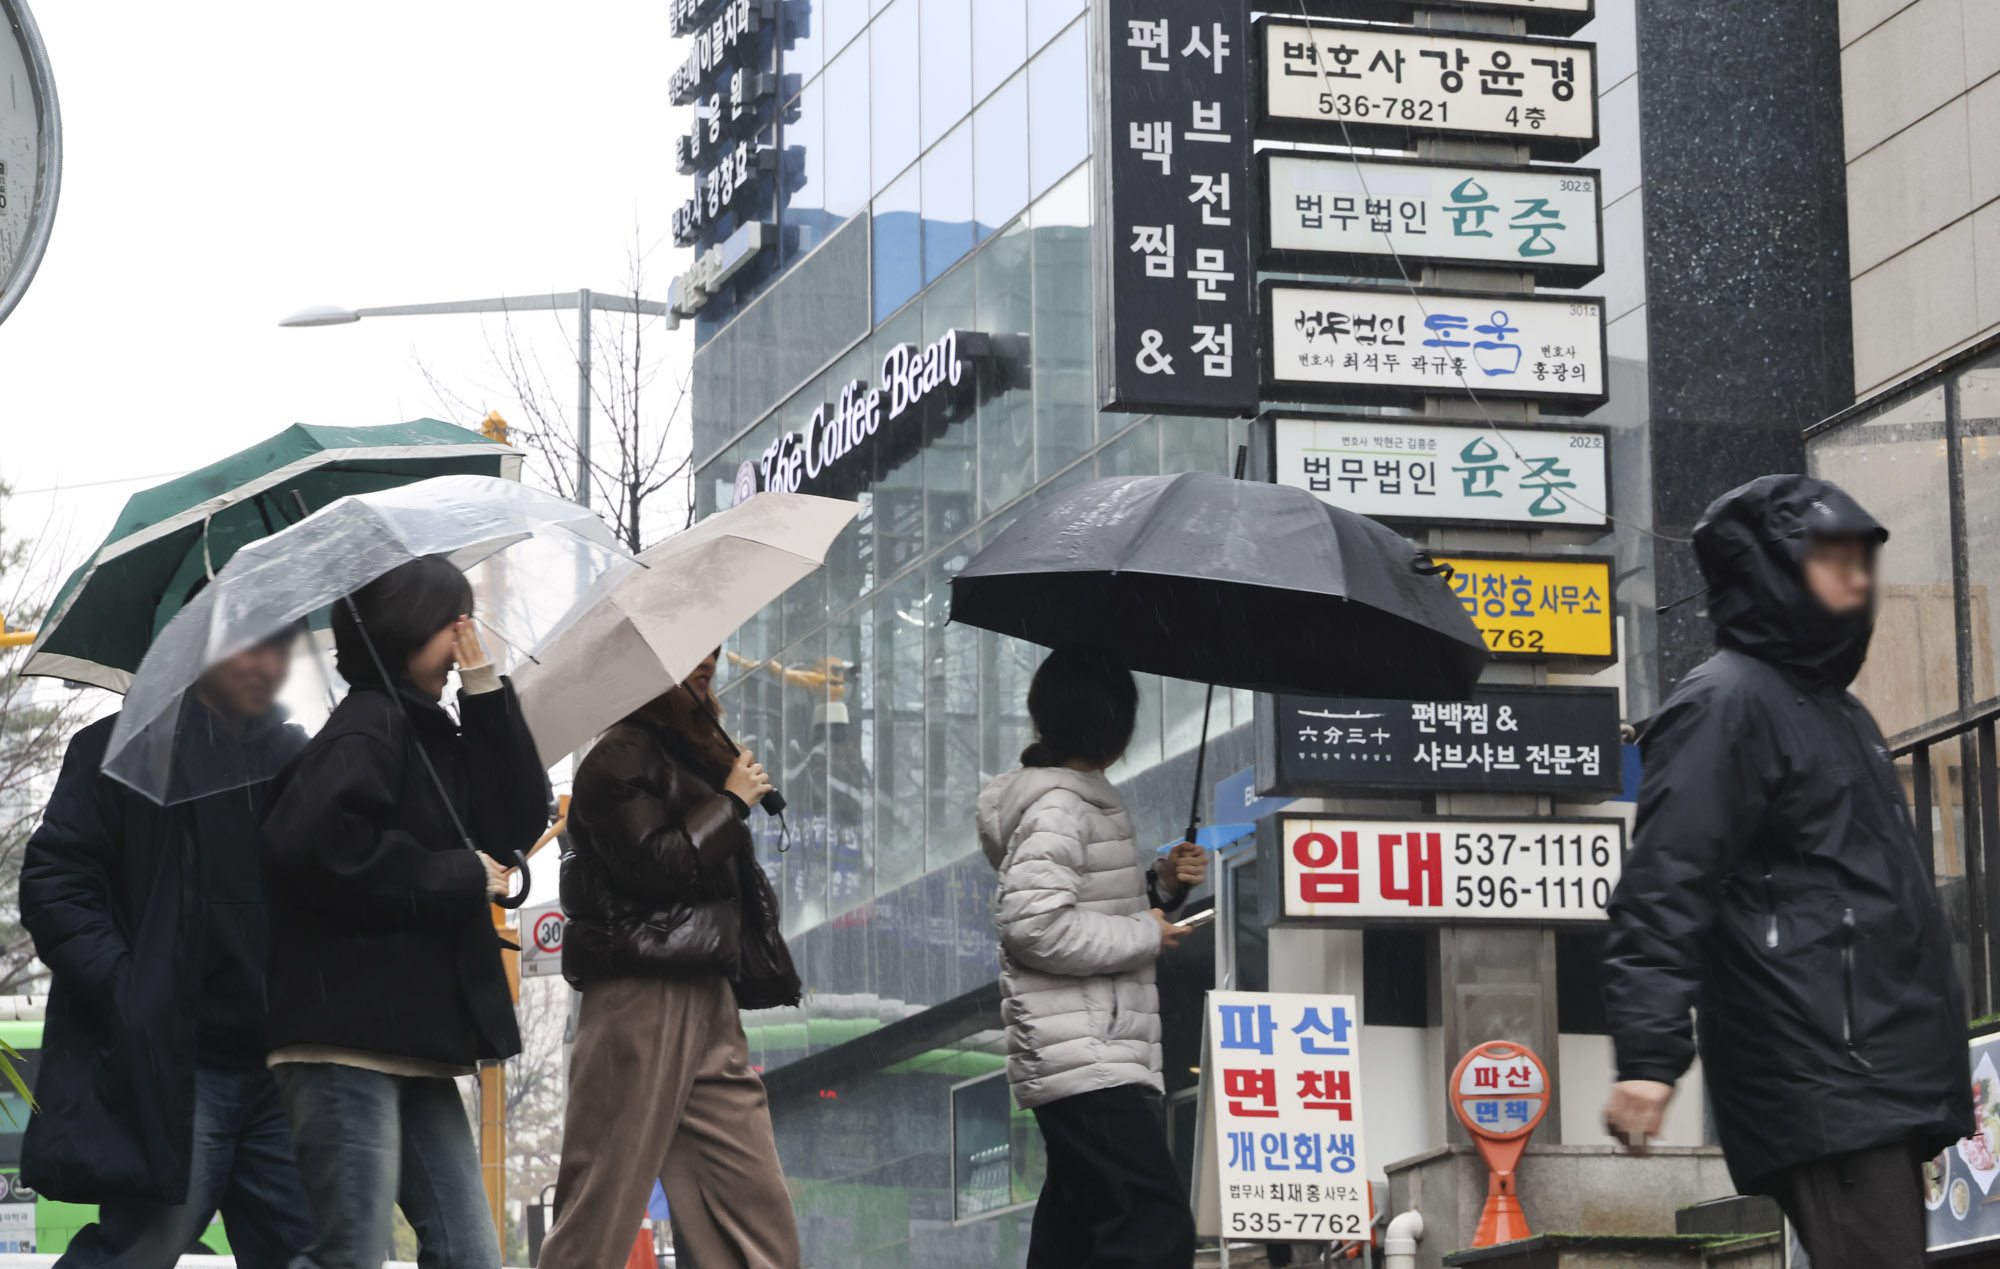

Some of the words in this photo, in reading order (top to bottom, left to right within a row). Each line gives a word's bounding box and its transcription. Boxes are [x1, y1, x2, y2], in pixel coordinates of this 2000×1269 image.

[1283, 41, 1406, 83] 변호사
[1420, 48, 1575, 102] 강윤경
[1318, 93, 1449, 123] 536-7821
[1505, 106, 1547, 129] 4층
[1127, 18, 1175, 279] 편백찜
[672, 188, 702, 247] 변호사
[707, 141, 748, 218] 강창효
[1559, 178, 1593, 193] 302호
[1295, 194, 1428, 235] 법무법인
[1441, 176, 1567, 257] 윤중
[1569, 304, 1598, 317] 301호
[1294, 310, 1406, 346] 법무법인
[1135, 328, 1176, 376] &
[1298, 352, 1335, 368] 변호사
[1343, 352, 1400, 373] 최석두
[1541, 345, 1576, 359] 변호사
[1532, 362, 1586, 382] 홍광의
[760, 431, 803, 493] The
[805, 379, 881, 479] Coffee
[882, 328, 962, 420] Bean
[1341, 436, 1368, 447] 변호사
[1569, 435, 1603, 449] 202호
[1303, 456, 1437, 496] 법무법인
[1451, 436, 1577, 517] 윤중
[1454, 573, 1535, 618] 김창호
[1539, 585, 1602, 614] 사무소
[1479, 629, 1545, 650] 762
[1412, 702, 1489, 735] 편백찜
[1496, 705, 1518, 731] &
[1298, 726, 1391, 745] 六分三十
[1413, 741, 1520, 772] 샤브샤브
[1525, 744, 1600, 775] 전문점
[1454, 833, 1611, 868] 537-1116
[1293, 830, 1444, 906] 임대
[1455, 875, 1611, 909] 596-1110
[541, 922, 561, 944] 30
[1218, 1004, 1353, 1056] 파산
[1474, 1066, 1532, 1088] 파산
[1223, 1068, 1353, 1121] 면책
[1474, 1100, 1529, 1123] 면책
[1227, 1131, 1356, 1174] 개인회생
[1270, 1183, 1321, 1203] 최재홍
[1324, 1186, 1359, 1201] 사무소
[1232, 1212, 1361, 1234] 535-7762
